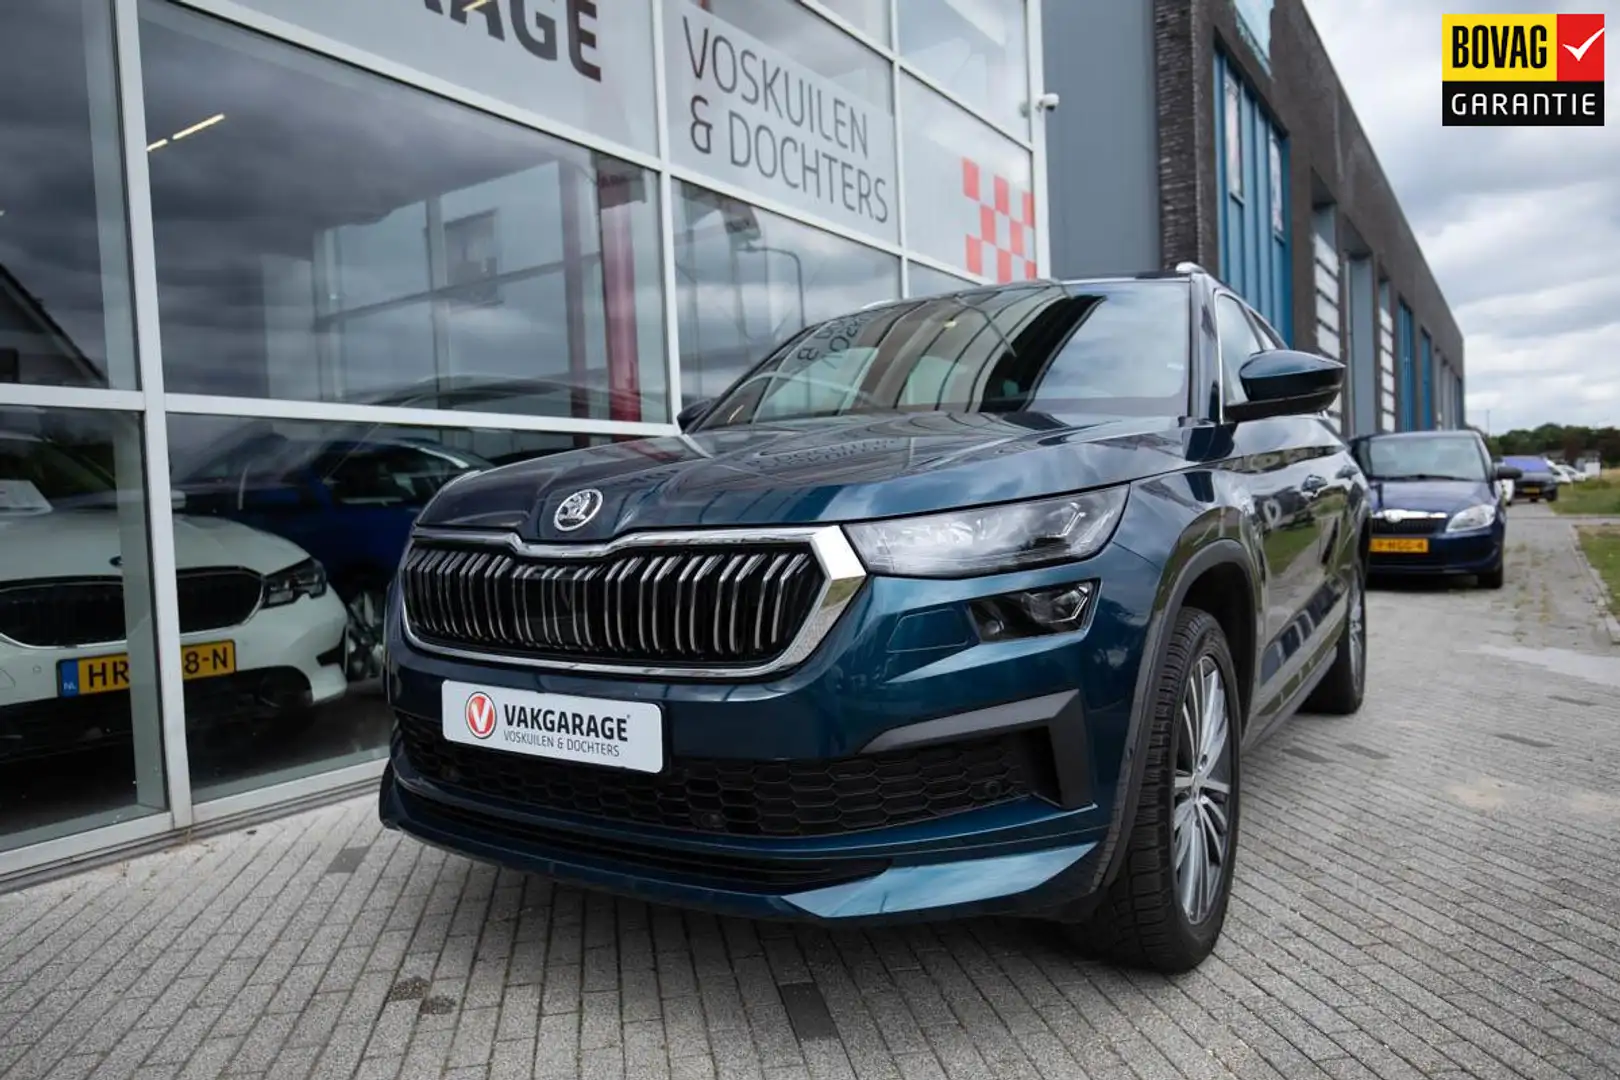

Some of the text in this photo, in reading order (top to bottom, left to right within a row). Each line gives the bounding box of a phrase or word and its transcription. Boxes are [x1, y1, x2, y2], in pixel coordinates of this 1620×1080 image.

[682, 16, 868, 160] VOSKUILEN
[690, 95, 888, 224] & DOCHTERS
[63, 682, 77, 691] NL
[504, 703, 628, 742] VAKGARAGE
[503, 730, 620, 757] VOSKUILEN & DOCHTERS
